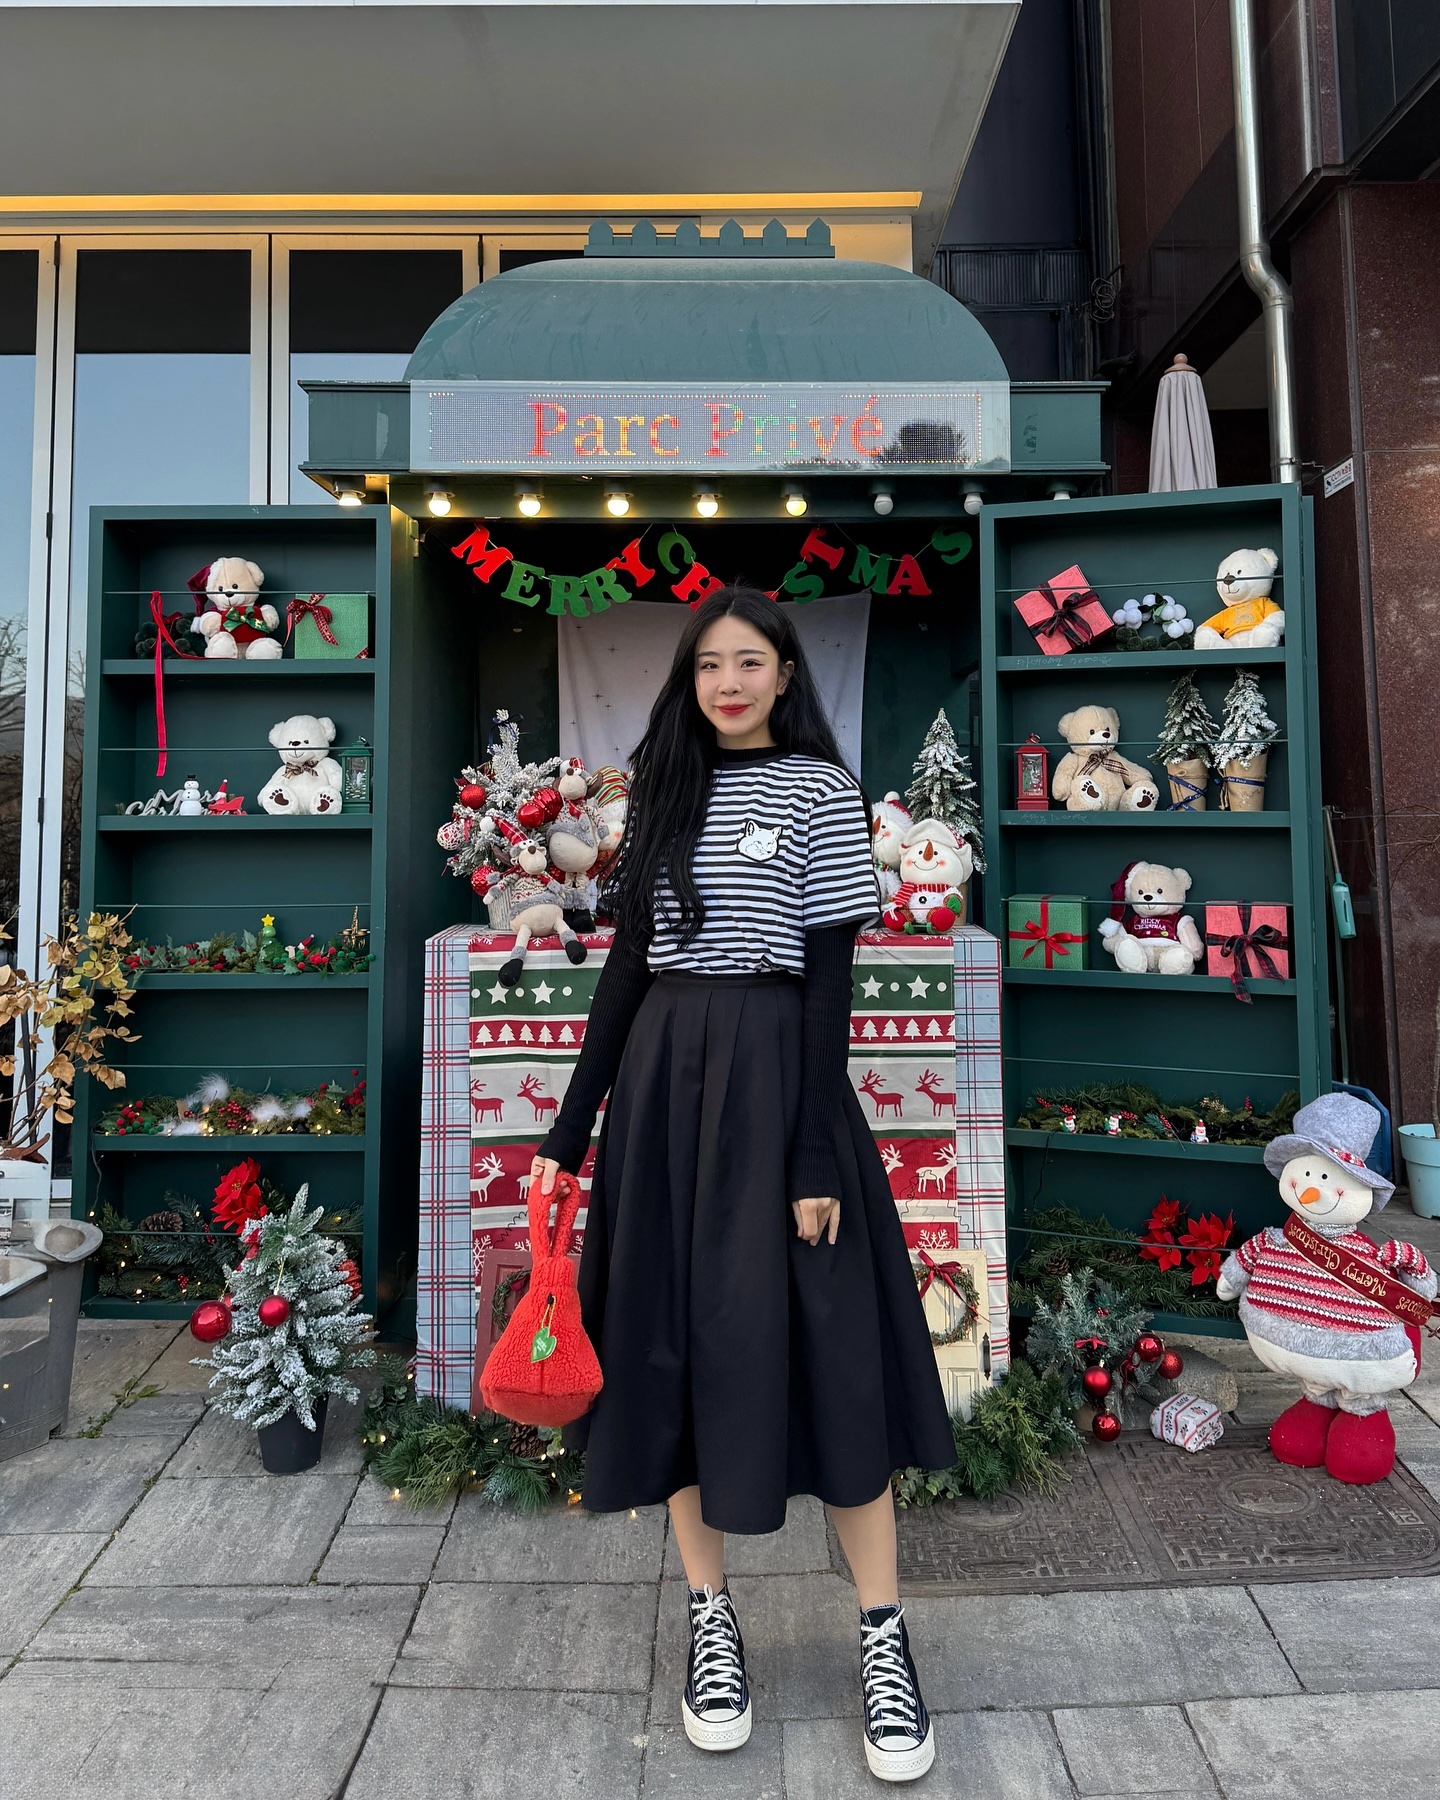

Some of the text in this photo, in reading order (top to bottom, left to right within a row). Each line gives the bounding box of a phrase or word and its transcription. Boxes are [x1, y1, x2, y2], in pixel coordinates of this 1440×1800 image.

[527, 395, 883, 456] Parc Privé
[451, 523, 972, 617] MERRY CHSTMAS
[1288, 1223, 1387, 1297] Merry Christmas
